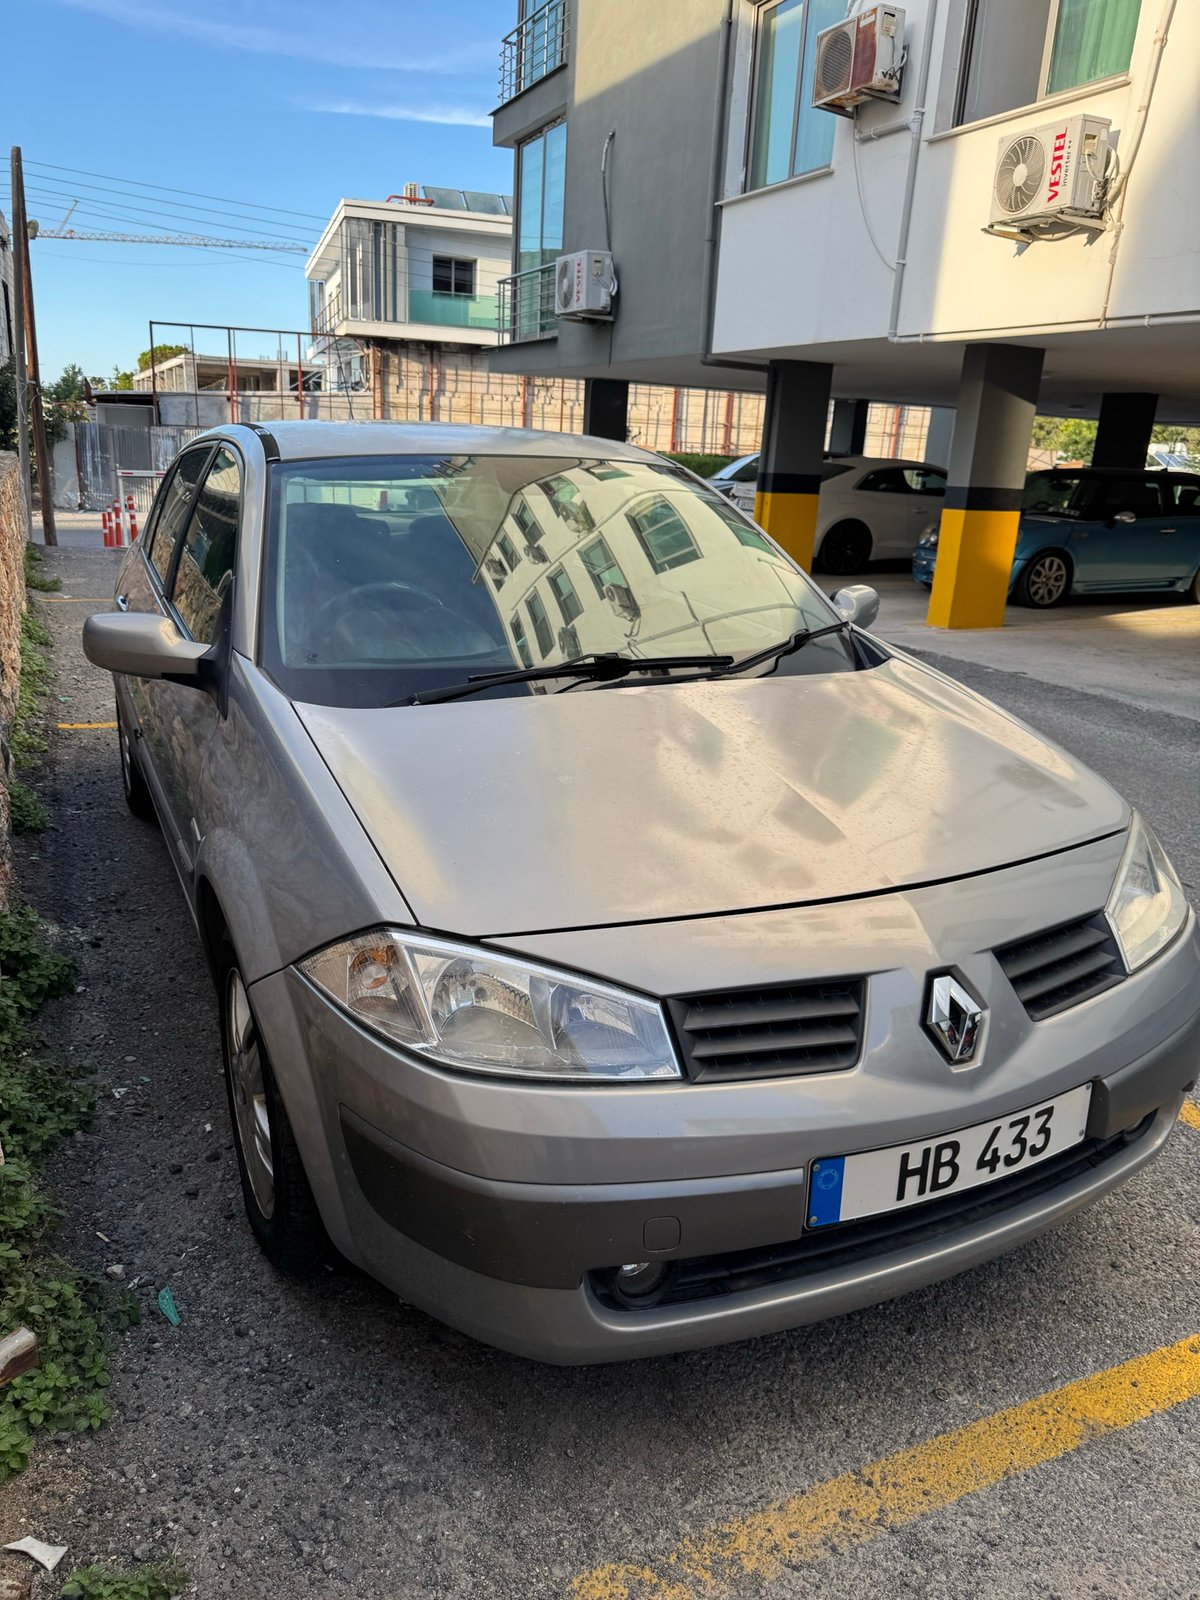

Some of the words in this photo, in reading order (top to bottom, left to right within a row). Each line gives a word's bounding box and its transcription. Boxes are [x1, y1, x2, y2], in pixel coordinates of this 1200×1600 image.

[1047, 127, 1068, 203] VESTEL
[896, 1140, 960, 1201] HB
[976, 1105, 1054, 1174] 433
